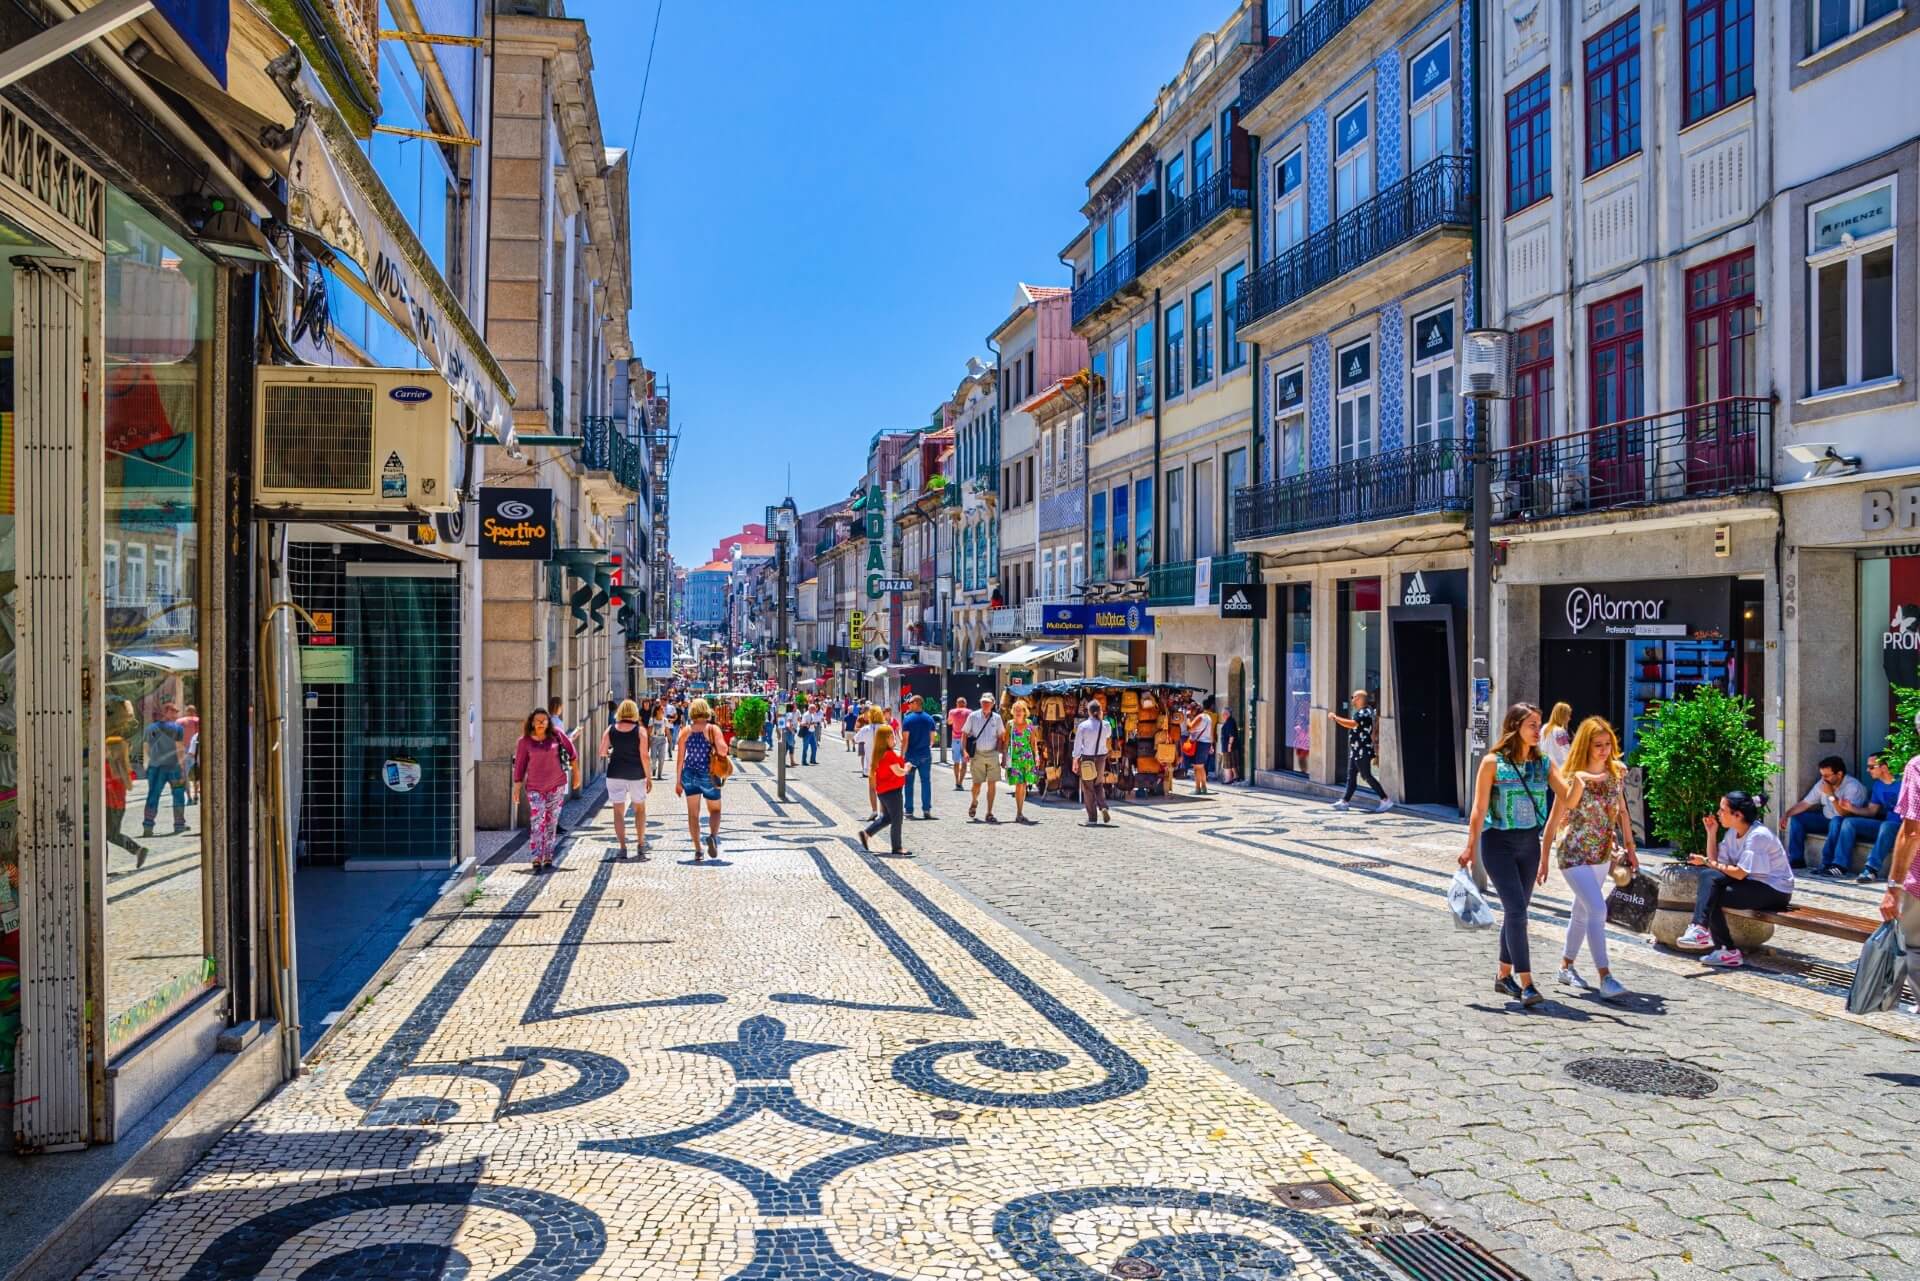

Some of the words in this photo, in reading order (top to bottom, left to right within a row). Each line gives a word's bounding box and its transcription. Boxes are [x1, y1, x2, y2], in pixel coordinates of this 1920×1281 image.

[394, 390, 428, 399] Carrier
[484, 518, 546, 543] Sportino
[879, 580, 913, 590] BAZAR
[1404, 594, 1431, 606] adidas
[1224, 602, 1252, 611] adidas
[1592, 593, 1664, 620] flormar
